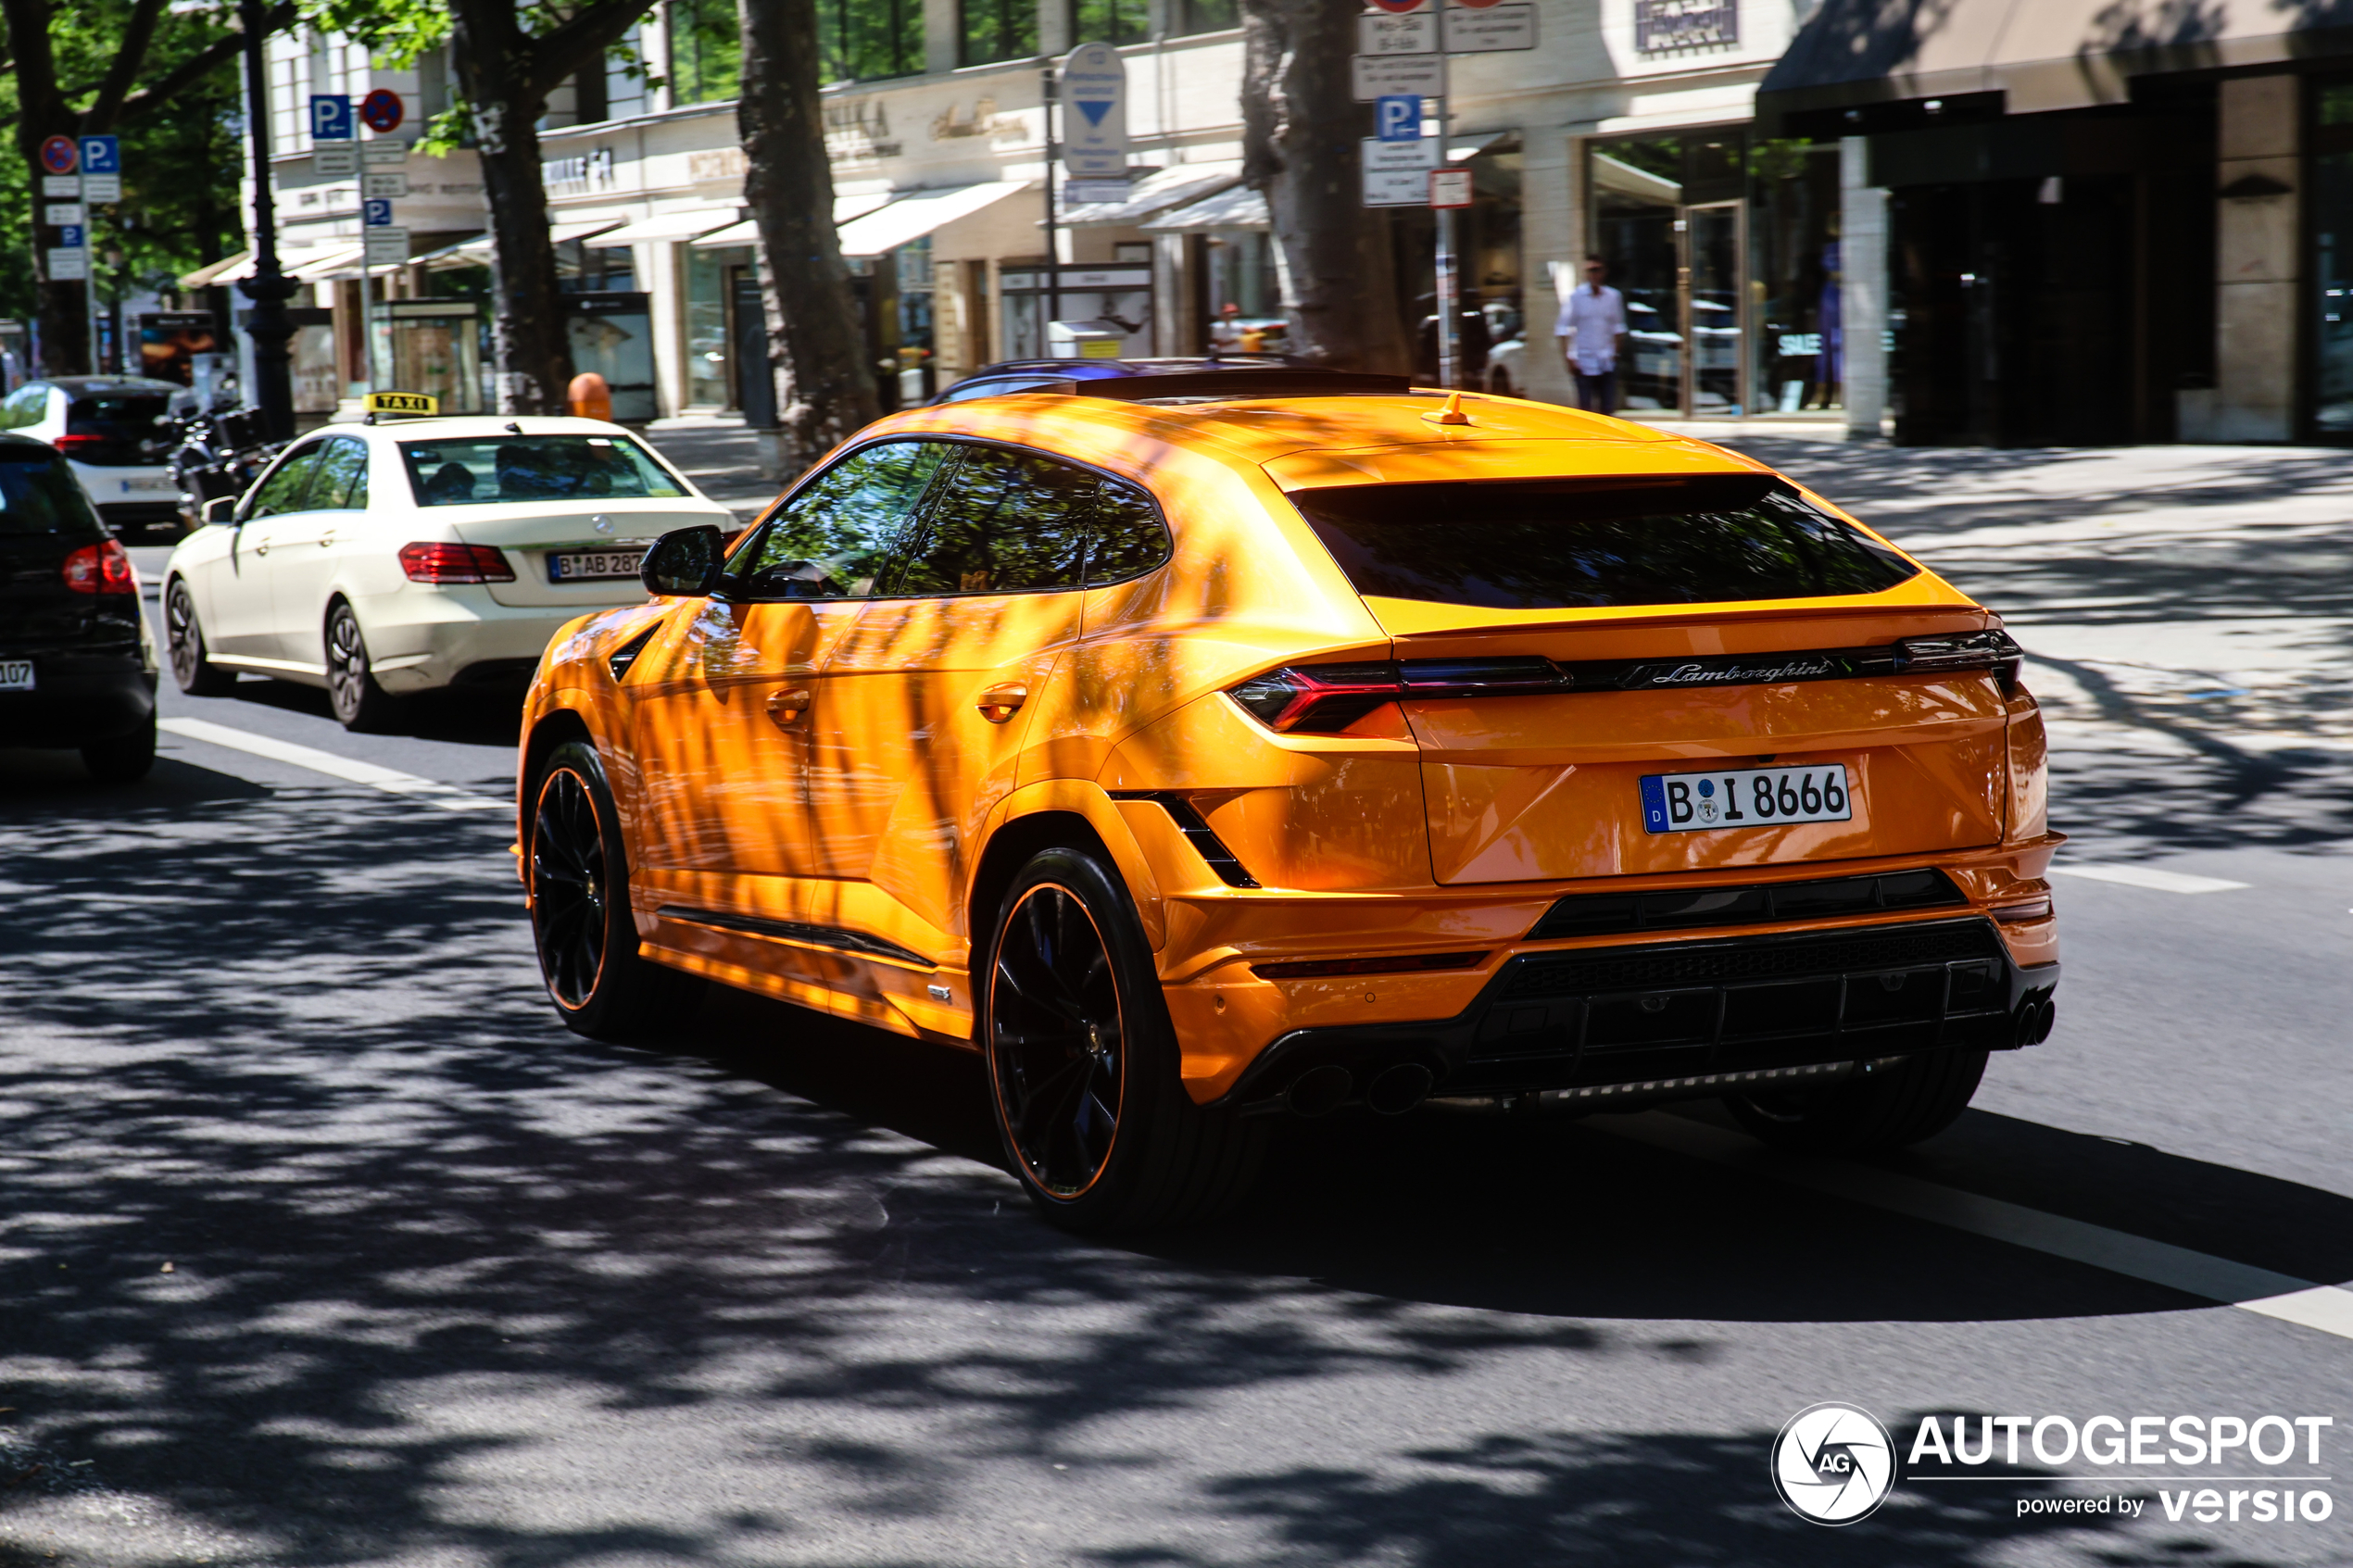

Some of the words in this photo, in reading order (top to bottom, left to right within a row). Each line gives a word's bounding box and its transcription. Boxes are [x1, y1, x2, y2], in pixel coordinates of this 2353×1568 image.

[315, 101, 339, 133] P
[1383, 100, 1412, 136] P
[86, 141, 107, 169] P
[381, 396, 424, 409] TAXI
[560, 557, 571, 574] B
[585, 555, 607, 573] AB
[1653, 662, 1828, 683] Lamborghini
[1667, 782, 1693, 823] B
[1723, 778, 1743, 820] I
[1753, 772, 1844, 818] 8666
[1653, 810, 1661, 822] D
